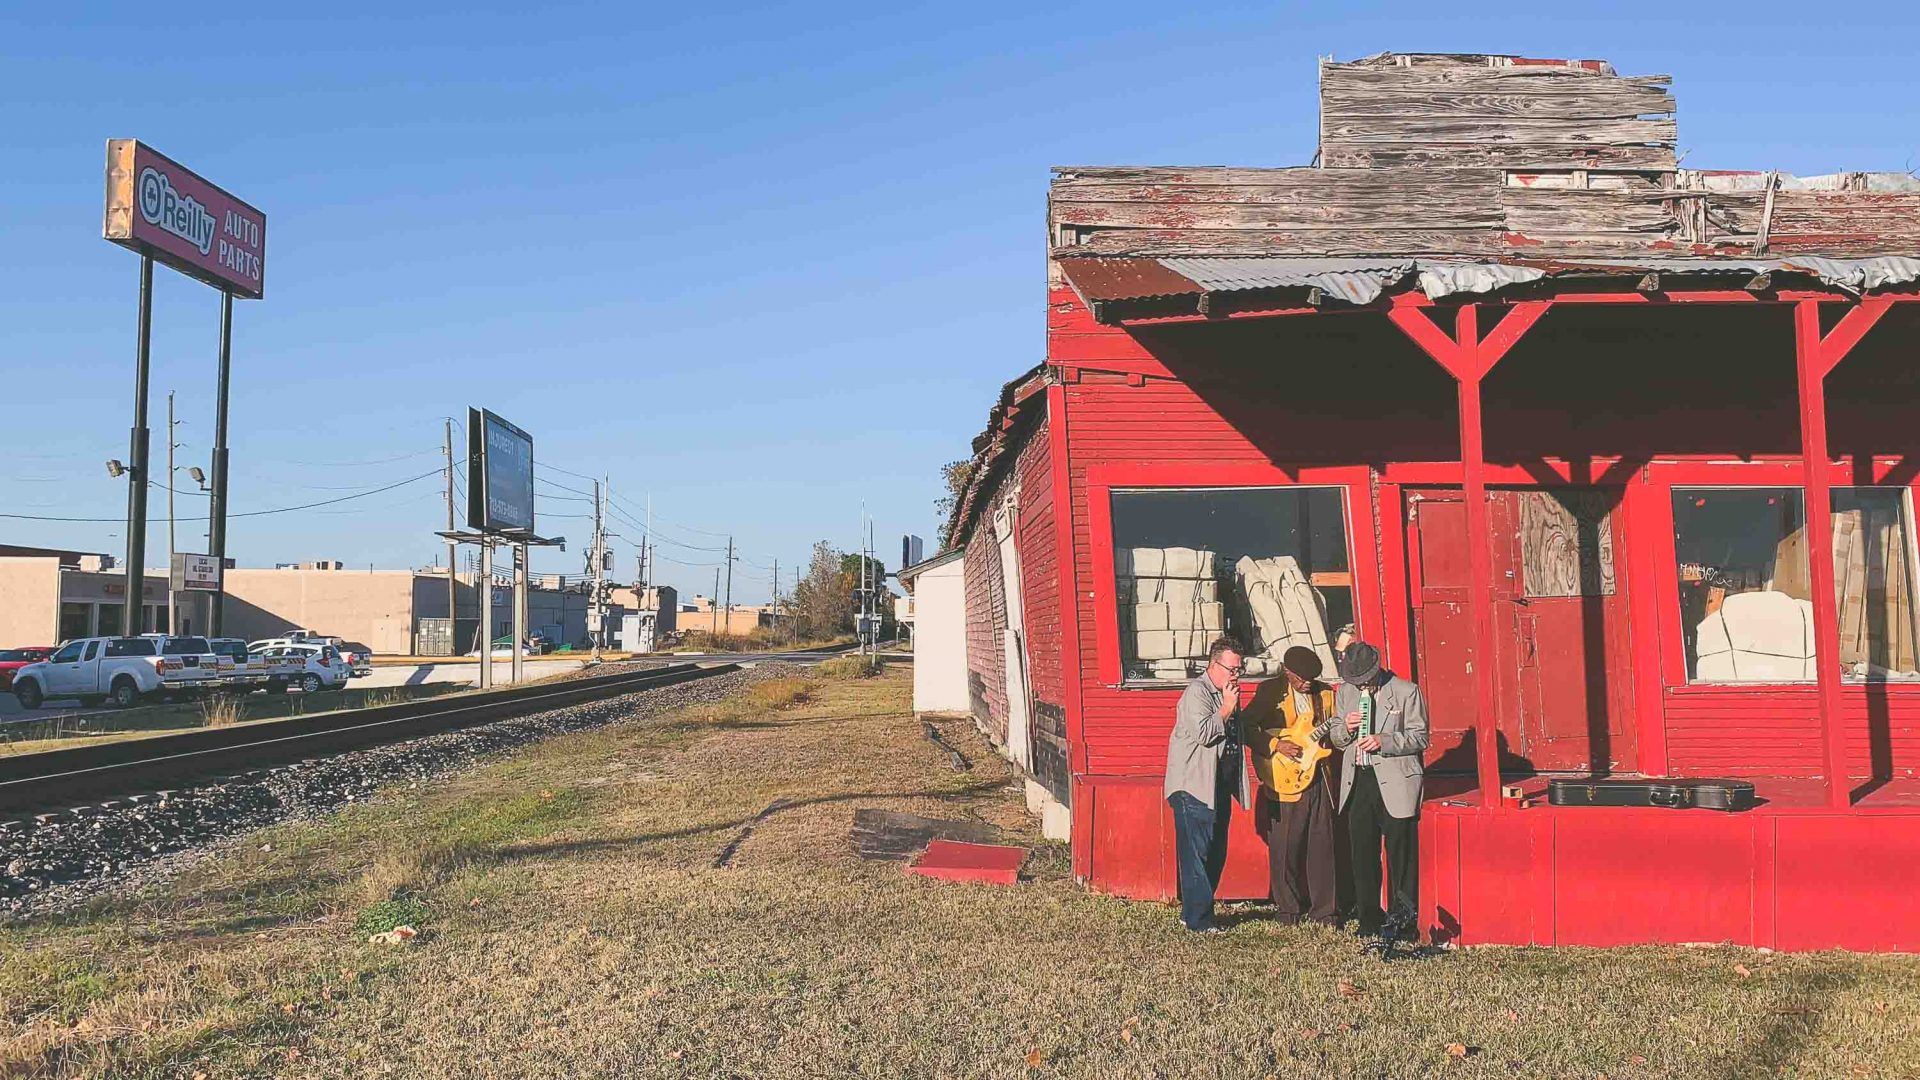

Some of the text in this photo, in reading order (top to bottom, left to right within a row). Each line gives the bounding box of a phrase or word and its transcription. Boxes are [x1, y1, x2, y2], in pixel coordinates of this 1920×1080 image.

[140, 169, 215, 254] O'Reilly
[224, 210, 258, 248] AUTO
[219, 239, 260, 281] PARTS
